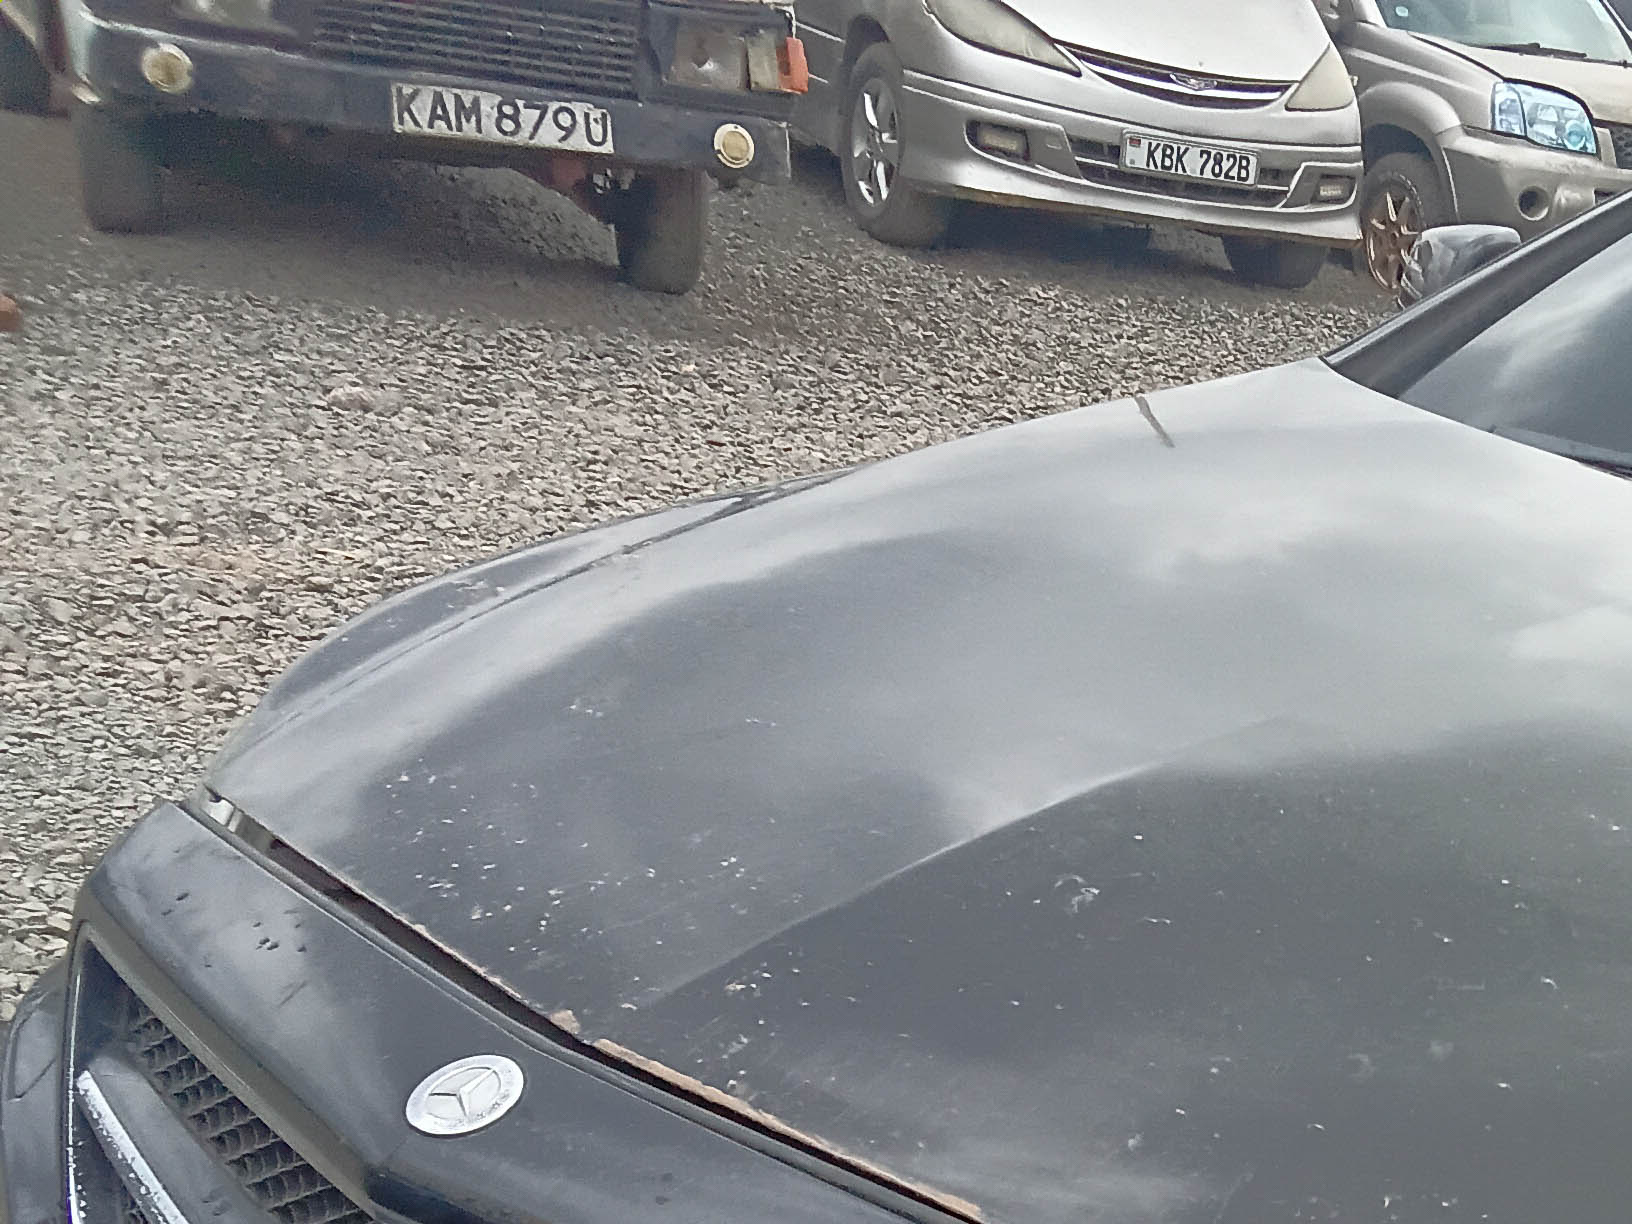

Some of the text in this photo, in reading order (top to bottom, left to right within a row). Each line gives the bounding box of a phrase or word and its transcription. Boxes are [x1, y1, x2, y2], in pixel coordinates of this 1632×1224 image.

[396, 85, 609, 147] KAM 879U
[1145, 141, 1251, 182] KBK 782B
